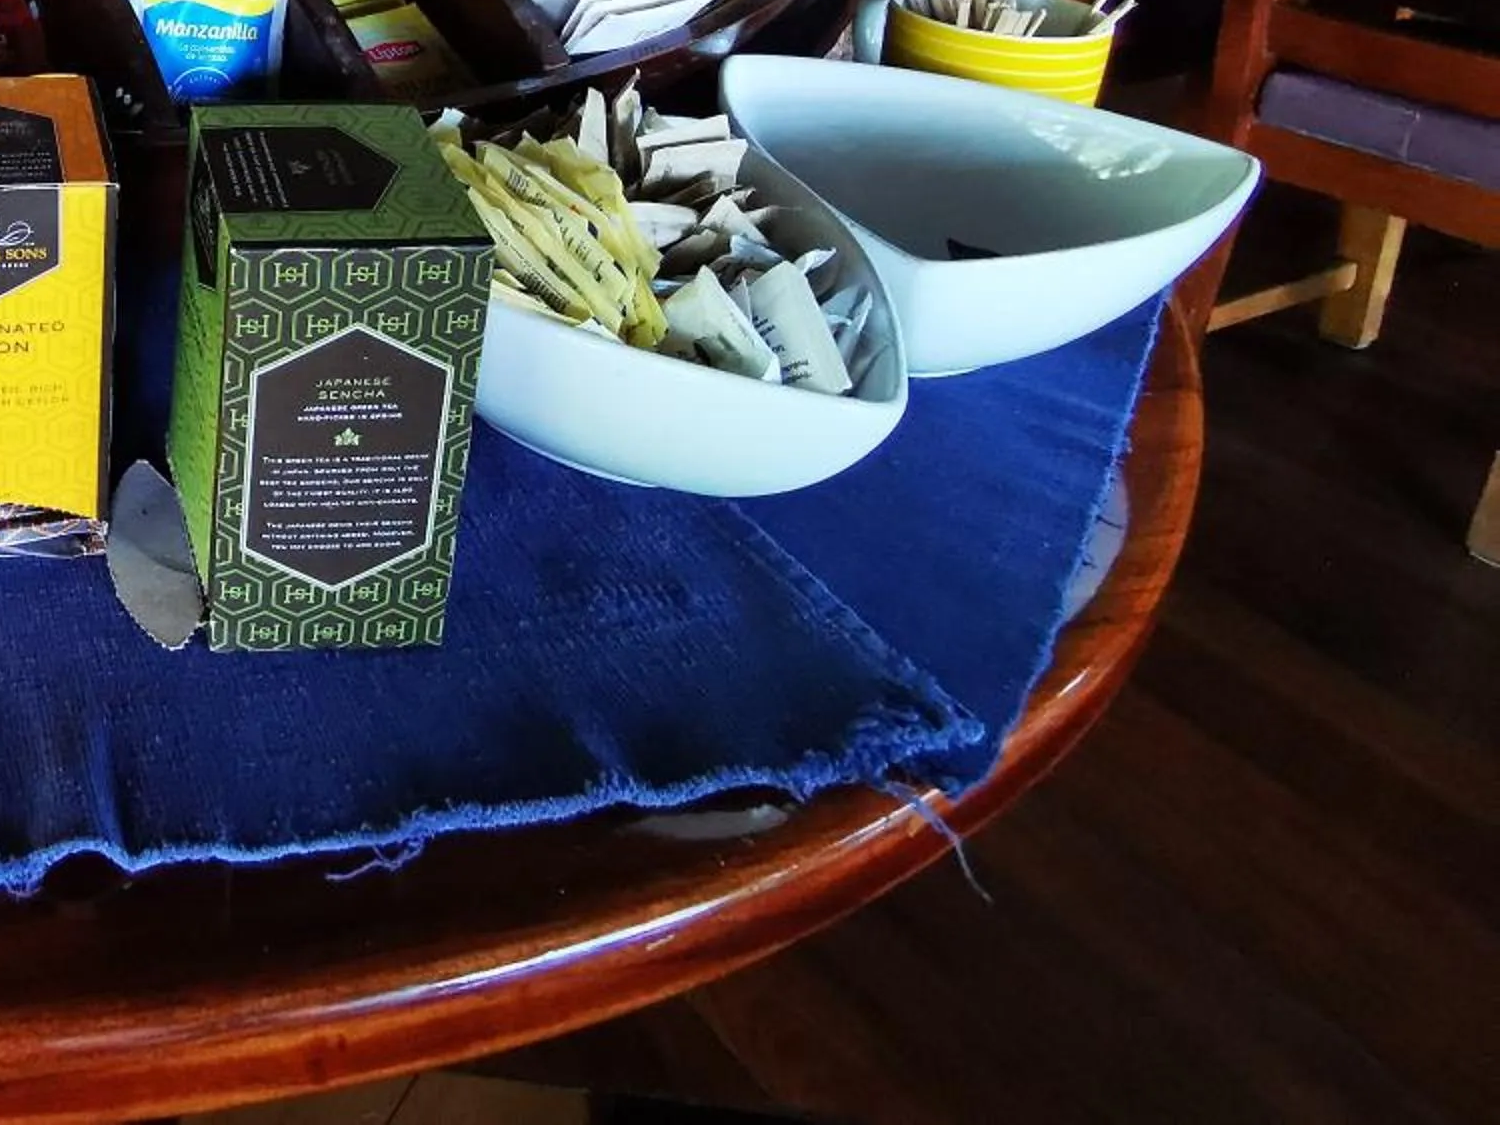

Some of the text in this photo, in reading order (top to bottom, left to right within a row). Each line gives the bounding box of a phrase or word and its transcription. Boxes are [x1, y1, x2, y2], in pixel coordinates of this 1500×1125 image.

[156, 19, 258, 40] Manzanilla
[368, 45, 419, 59] Lipton
[5, 247, 47, 260] SONS
[315, 376, 392, 388] JAPANESE
[318, 389, 386, 400] SENCHA
